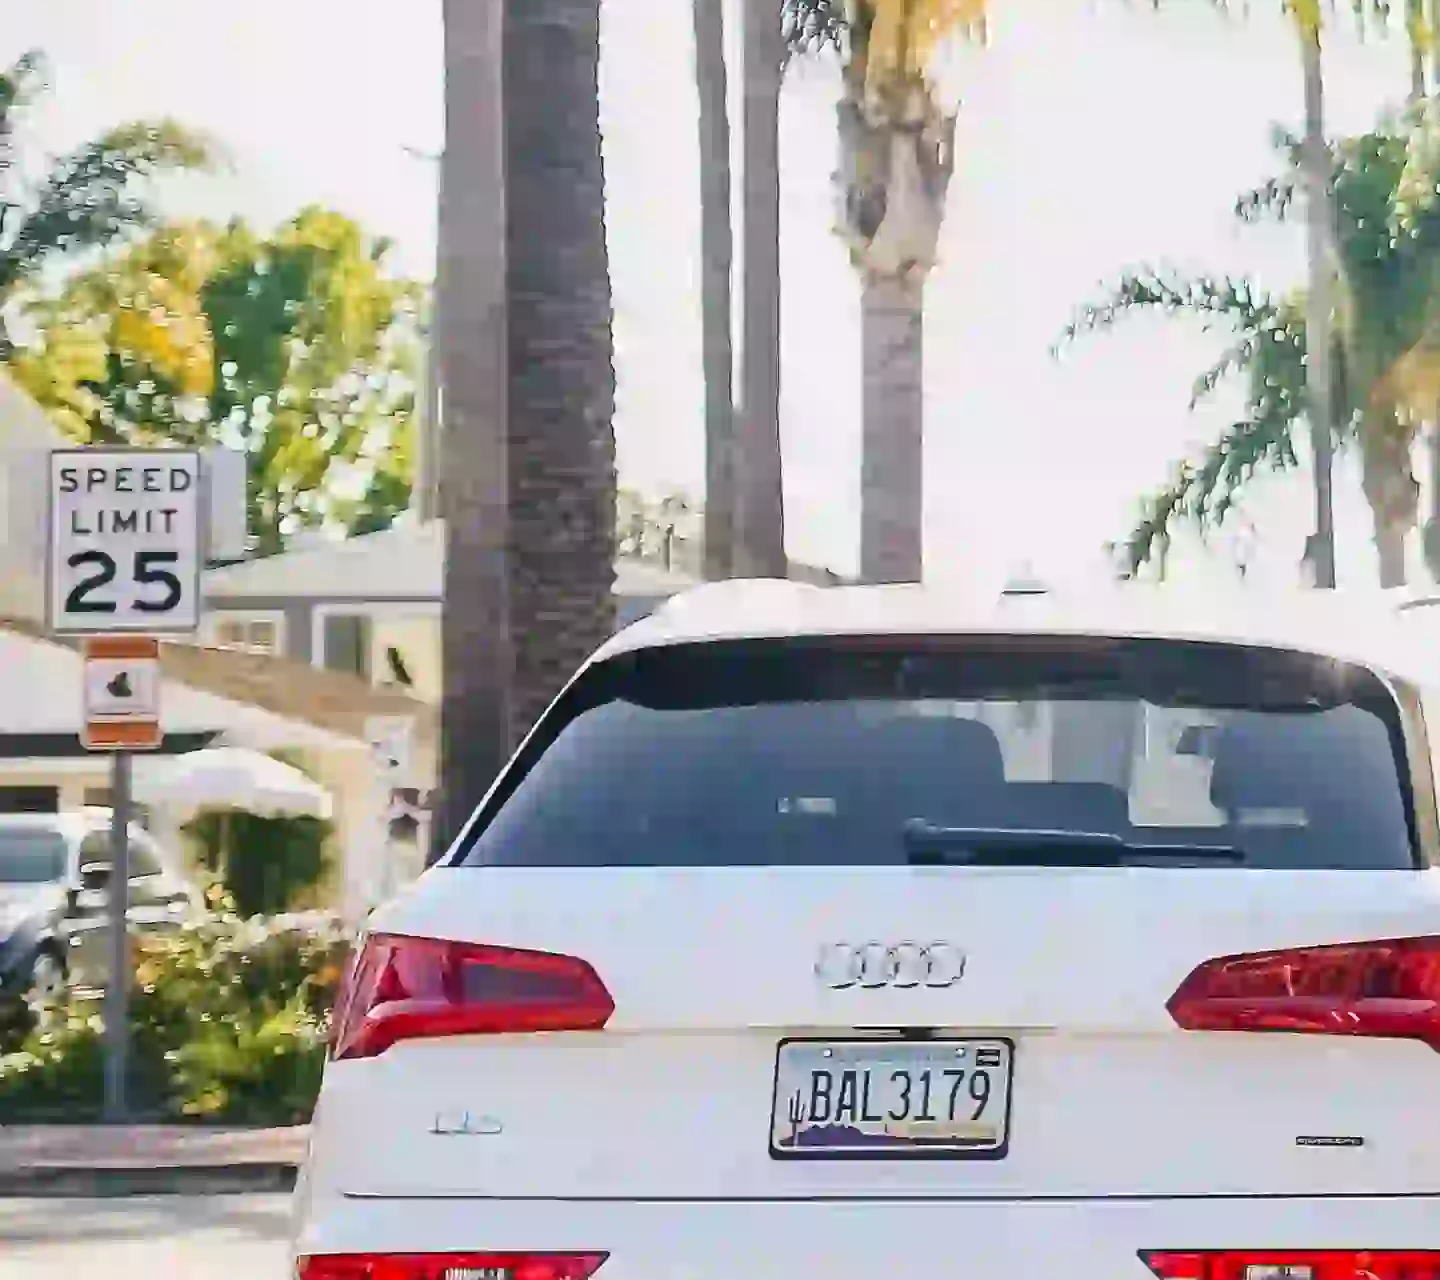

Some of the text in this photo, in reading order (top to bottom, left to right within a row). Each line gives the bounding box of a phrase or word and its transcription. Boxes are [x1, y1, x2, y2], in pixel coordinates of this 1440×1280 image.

[59, 467, 192, 493] SPEED
[71, 508, 178, 535] LIMIT
[64, 549, 182, 613] 25
[807, 1069, 991, 1122] BAL3179
